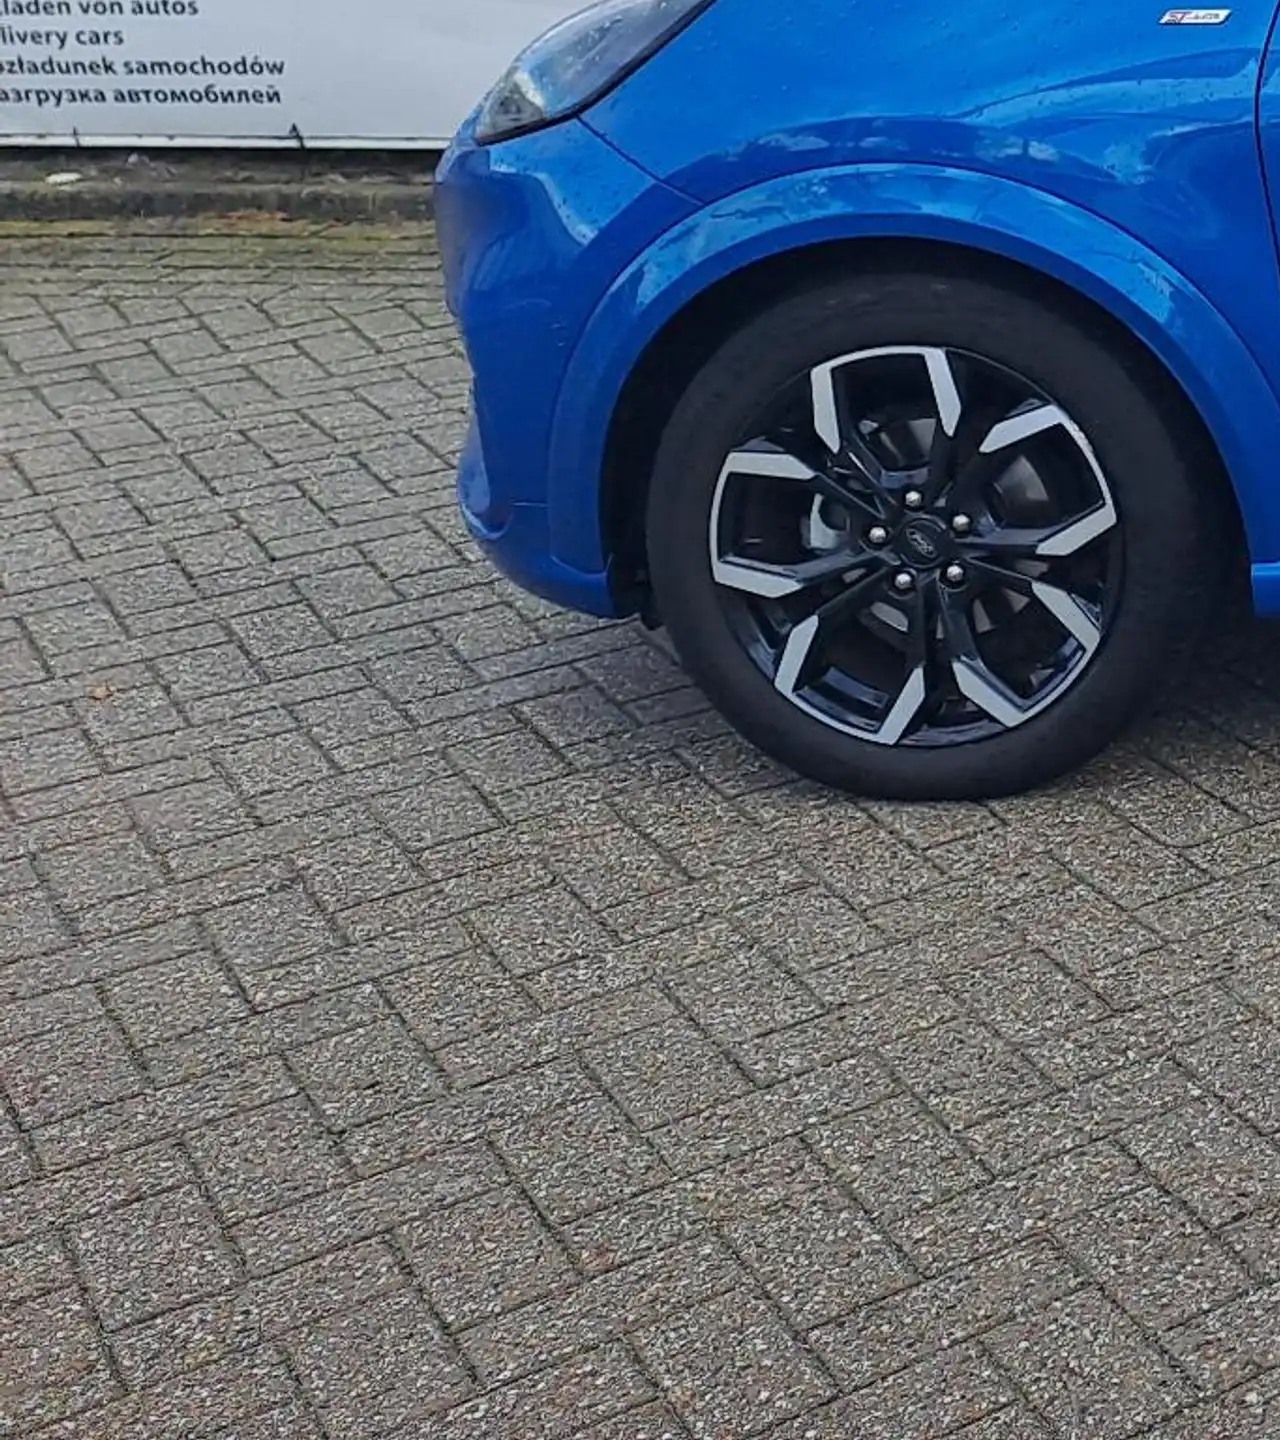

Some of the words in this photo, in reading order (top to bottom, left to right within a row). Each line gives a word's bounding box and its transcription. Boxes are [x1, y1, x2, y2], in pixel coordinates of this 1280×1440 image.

[78, 0, 123, 15] von
[75, 29, 124, 45] cars
[124, 55, 284, 75] samochodów
[114, 83, 281, 104] автомобилей
